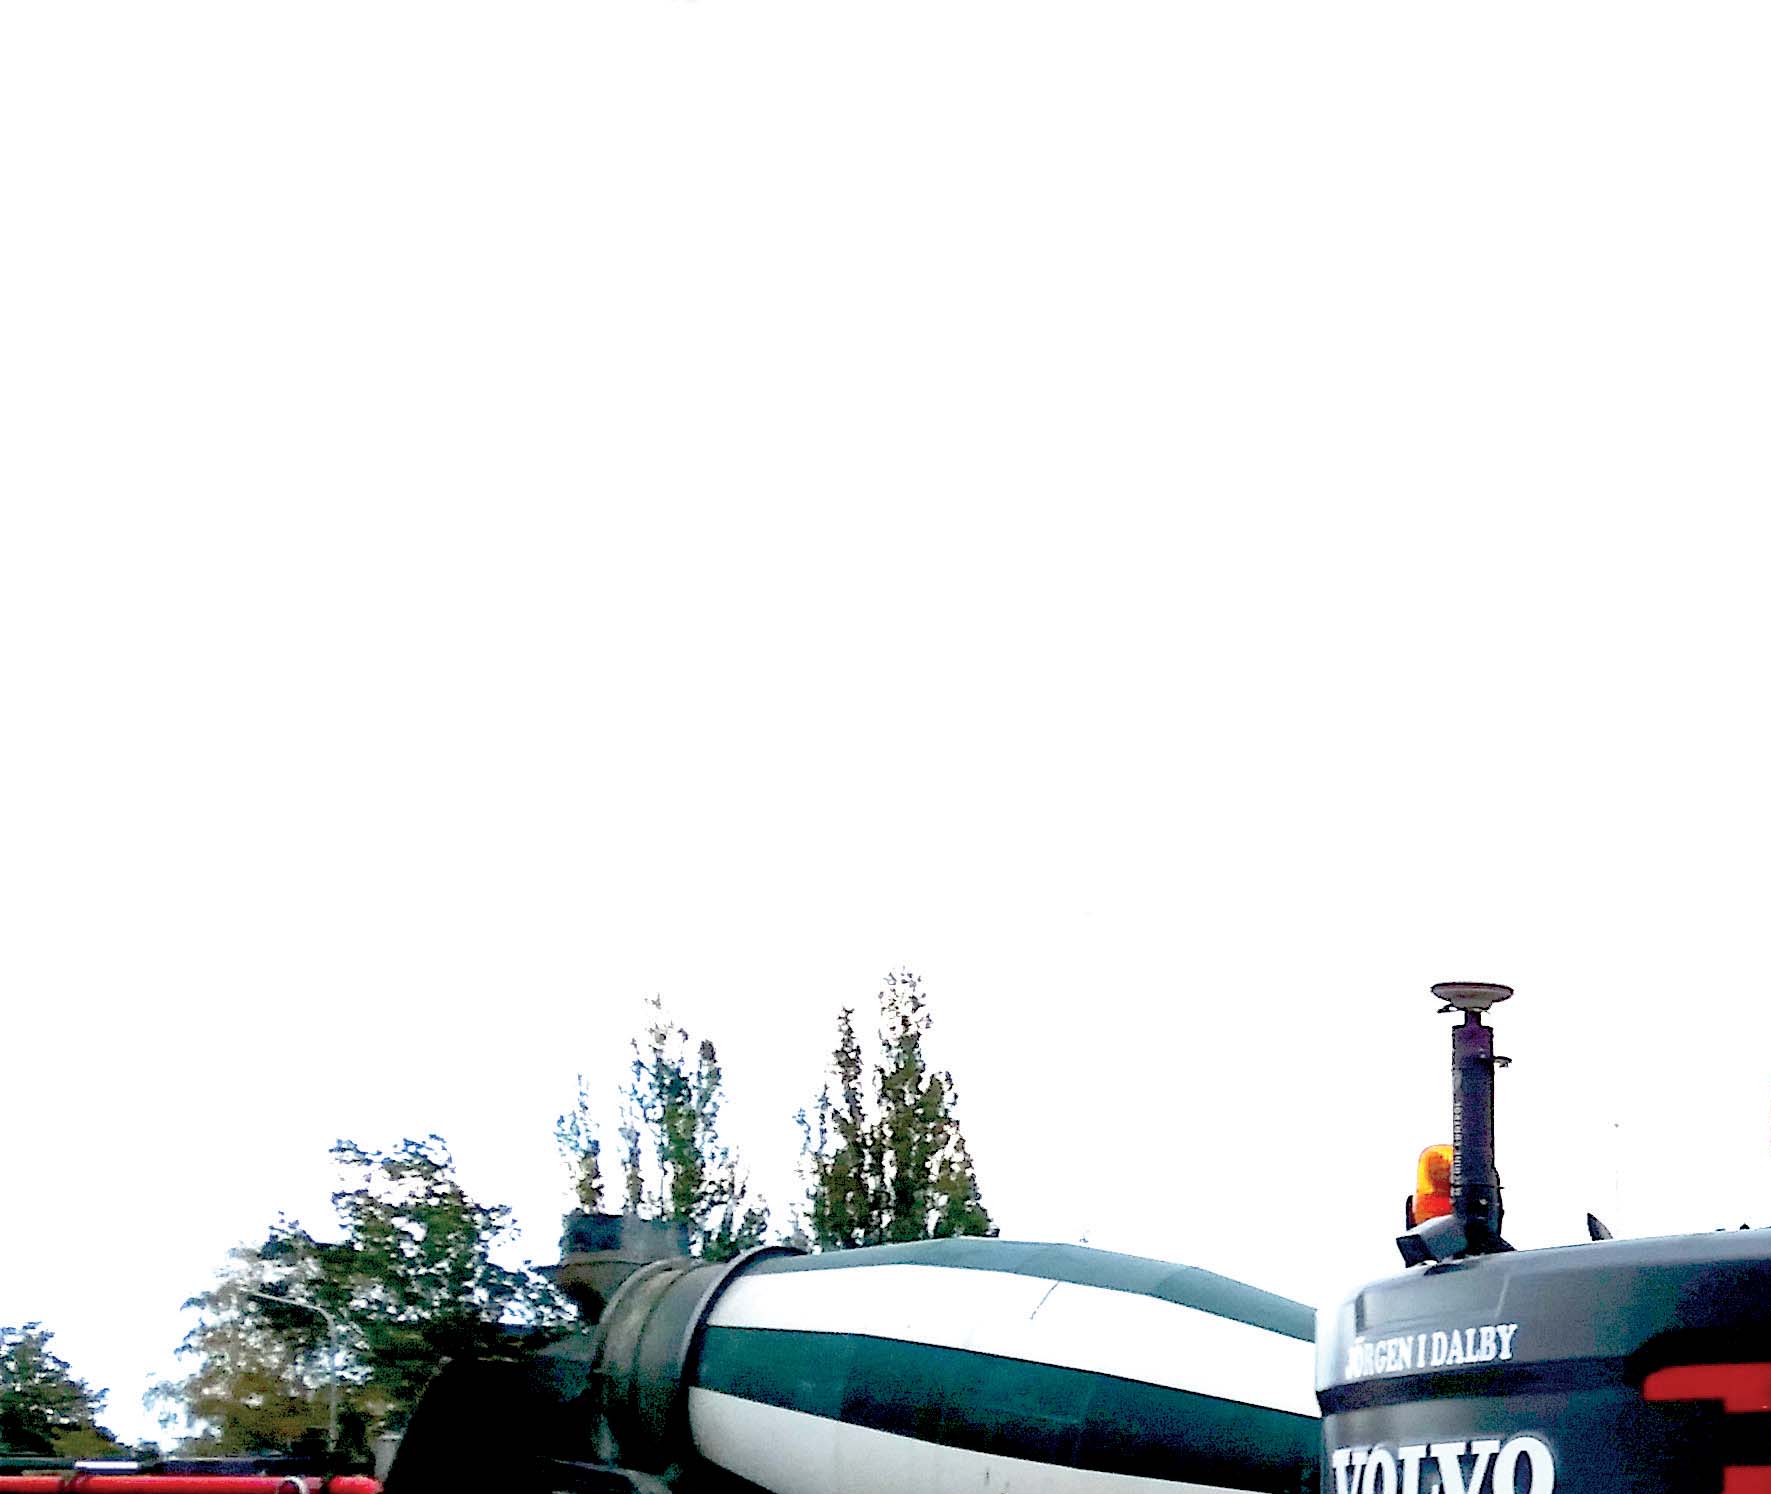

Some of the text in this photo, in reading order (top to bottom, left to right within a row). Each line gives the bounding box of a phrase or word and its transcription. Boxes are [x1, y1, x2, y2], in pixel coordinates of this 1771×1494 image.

[1345, 1322, 1518, 1380] JÖRGEN I DALBY
